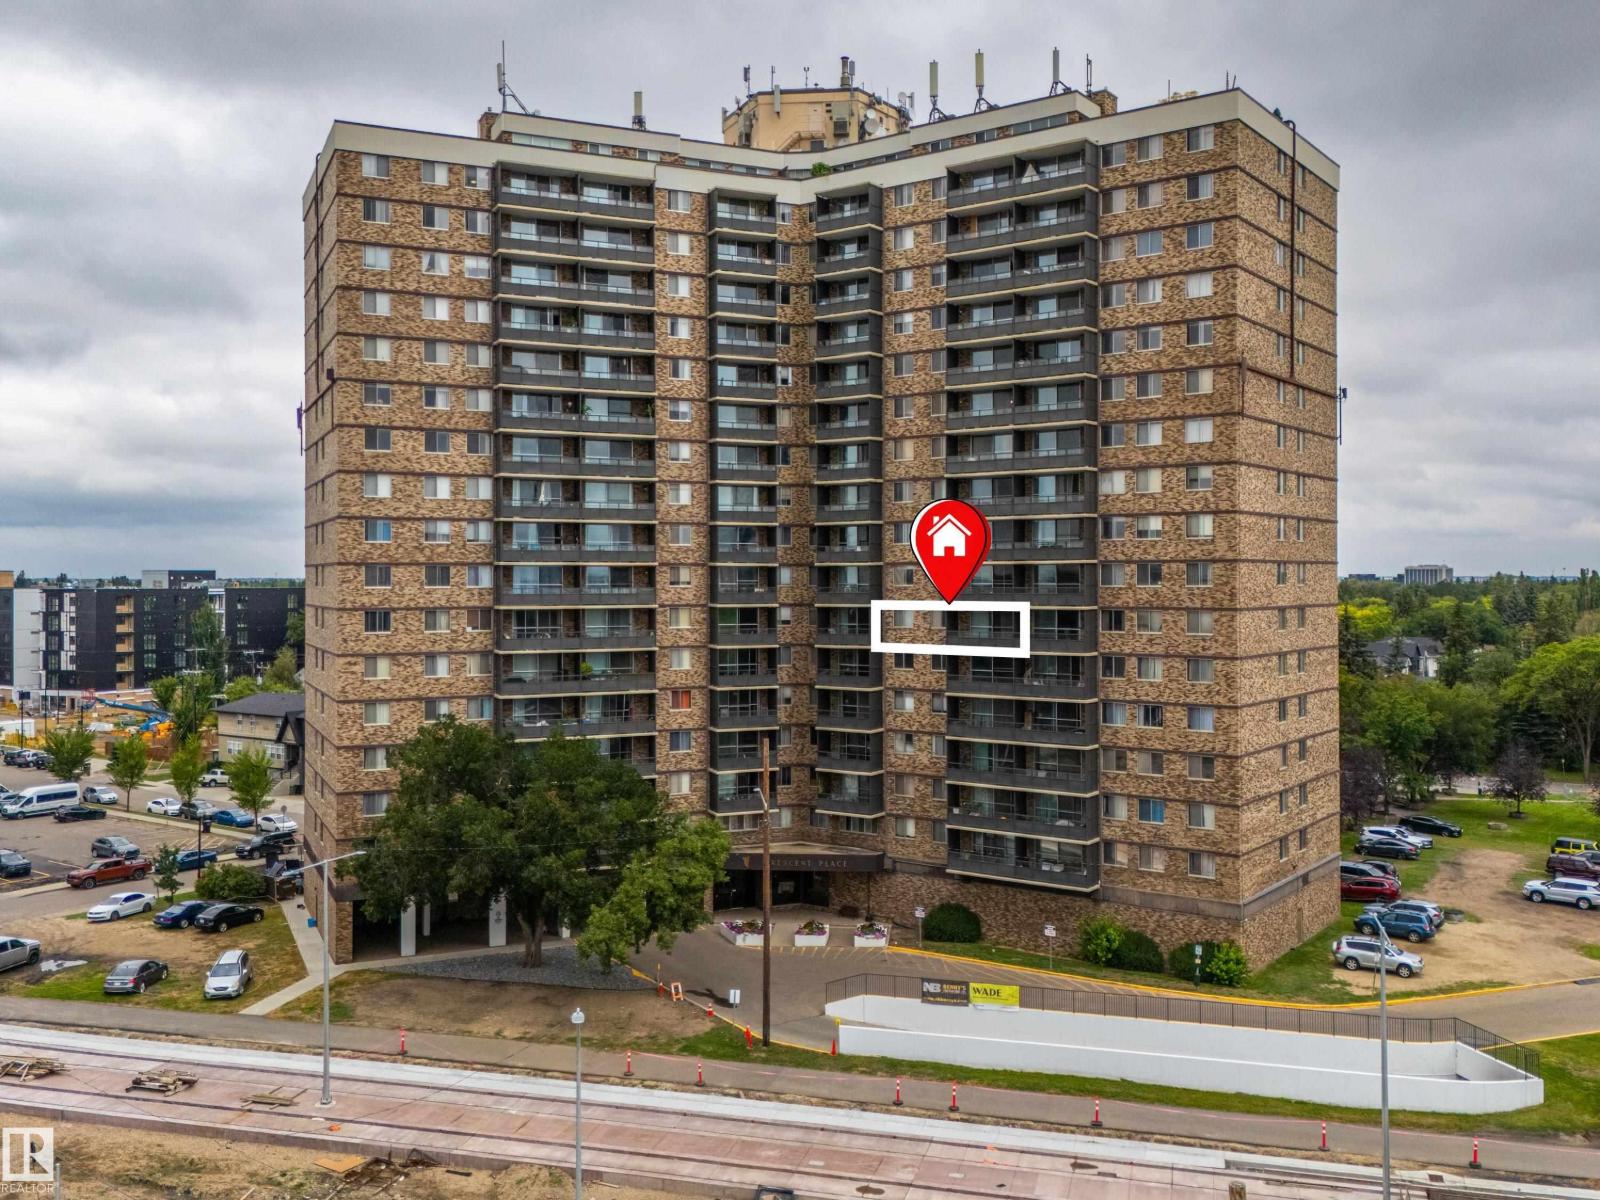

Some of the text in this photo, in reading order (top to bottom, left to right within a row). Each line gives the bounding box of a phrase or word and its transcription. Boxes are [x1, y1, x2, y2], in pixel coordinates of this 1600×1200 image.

[770, 859, 848, 868] RESCENT PLACE
[922, 982, 941, 993] NB
[972, 986, 1002, 997] WADE
